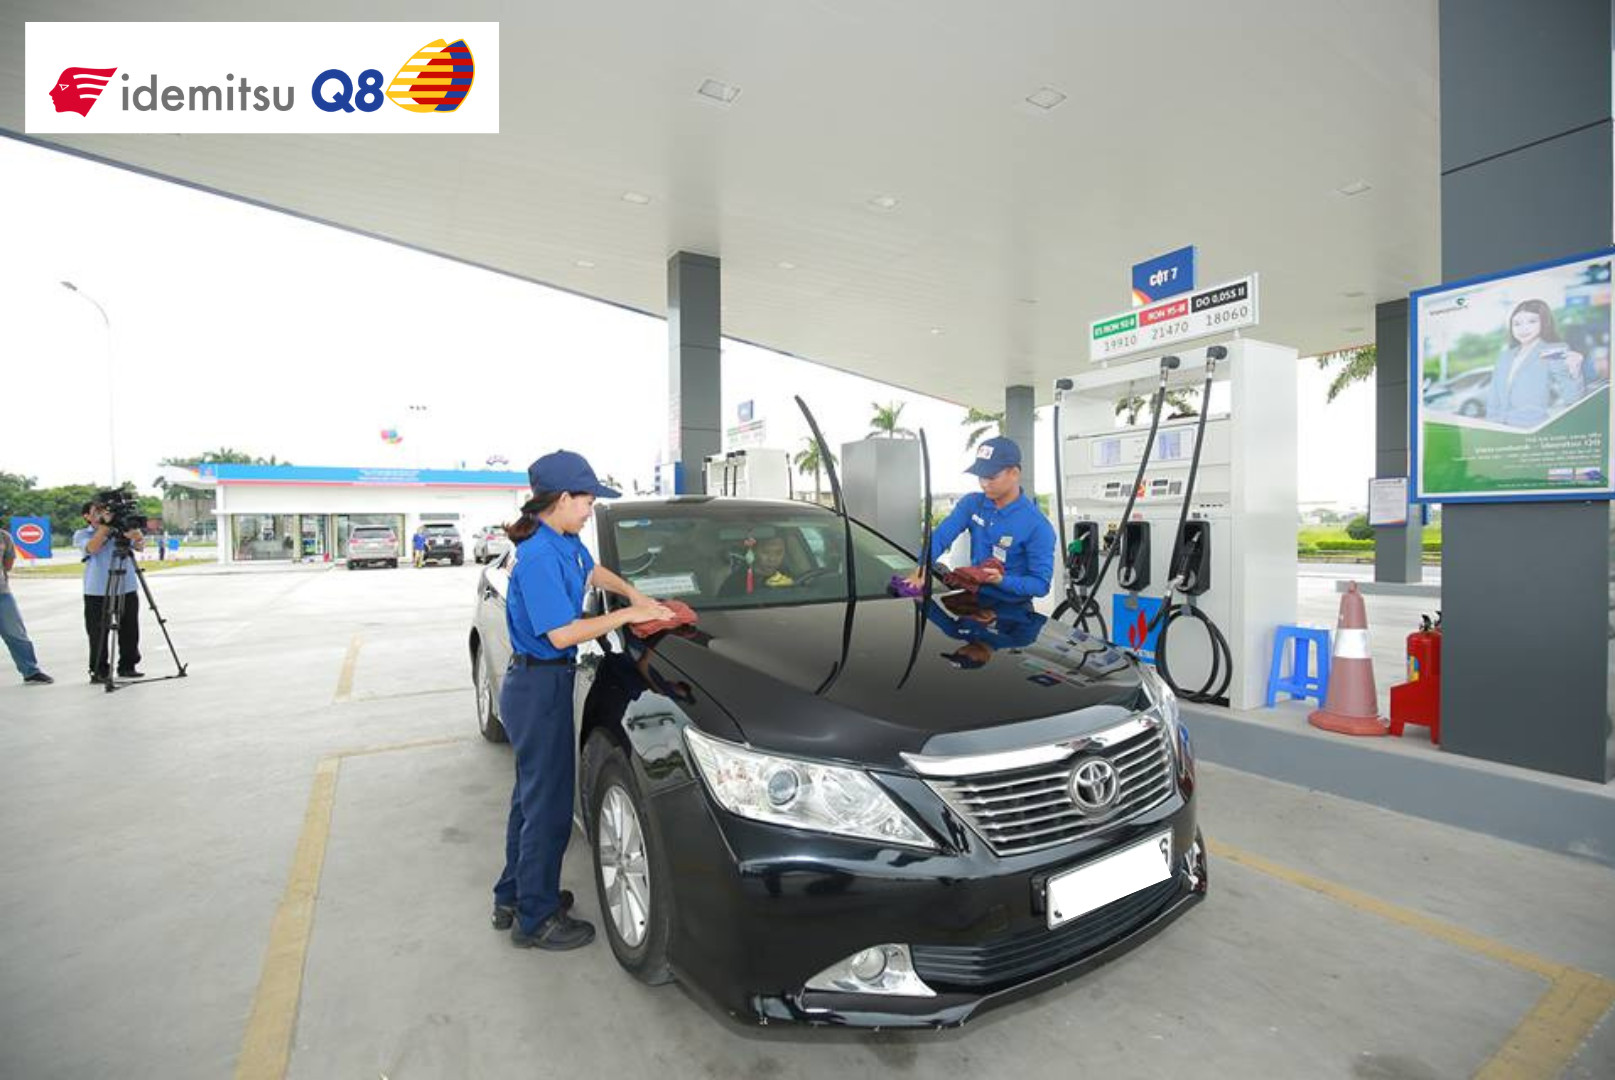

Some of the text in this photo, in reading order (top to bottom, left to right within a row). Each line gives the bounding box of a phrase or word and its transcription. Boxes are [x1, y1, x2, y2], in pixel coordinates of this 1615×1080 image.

[1171, 267, 1178, 280] 7
[1196, 296, 1210, 308] DO
[1206, 306, 1248, 326] 18060
[1151, 321, 1189, 340] 21470
